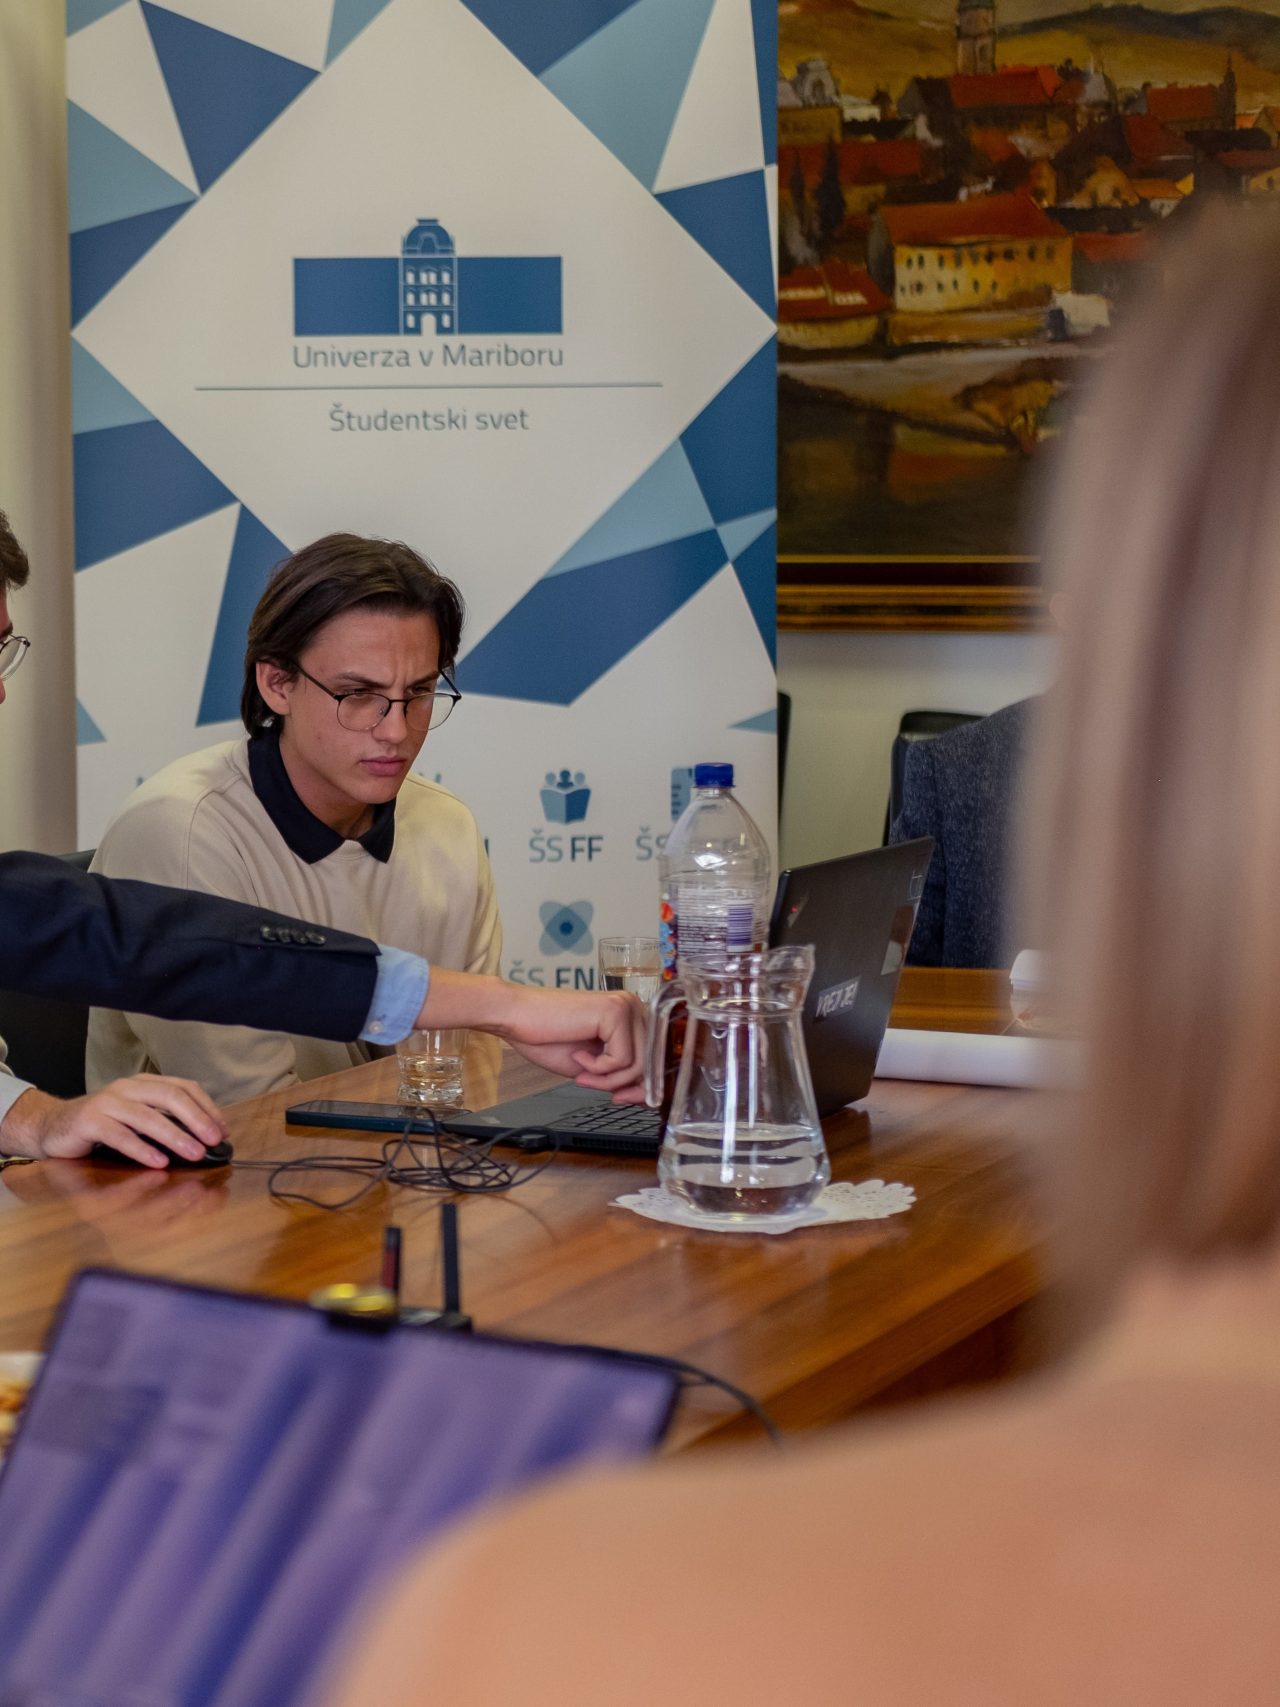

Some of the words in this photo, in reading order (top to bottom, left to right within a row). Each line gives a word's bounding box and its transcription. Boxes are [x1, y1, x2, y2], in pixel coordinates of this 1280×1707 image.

[293, 346, 410, 368] Univerza
[419, 350, 434, 367] v
[442, 344, 564, 367] Mariboru
[329, 403, 468, 432] Študentski
[475, 409, 529, 430] svet
[528, 828, 564, 863] ŠS
[570, 834, 604, 862] FF
